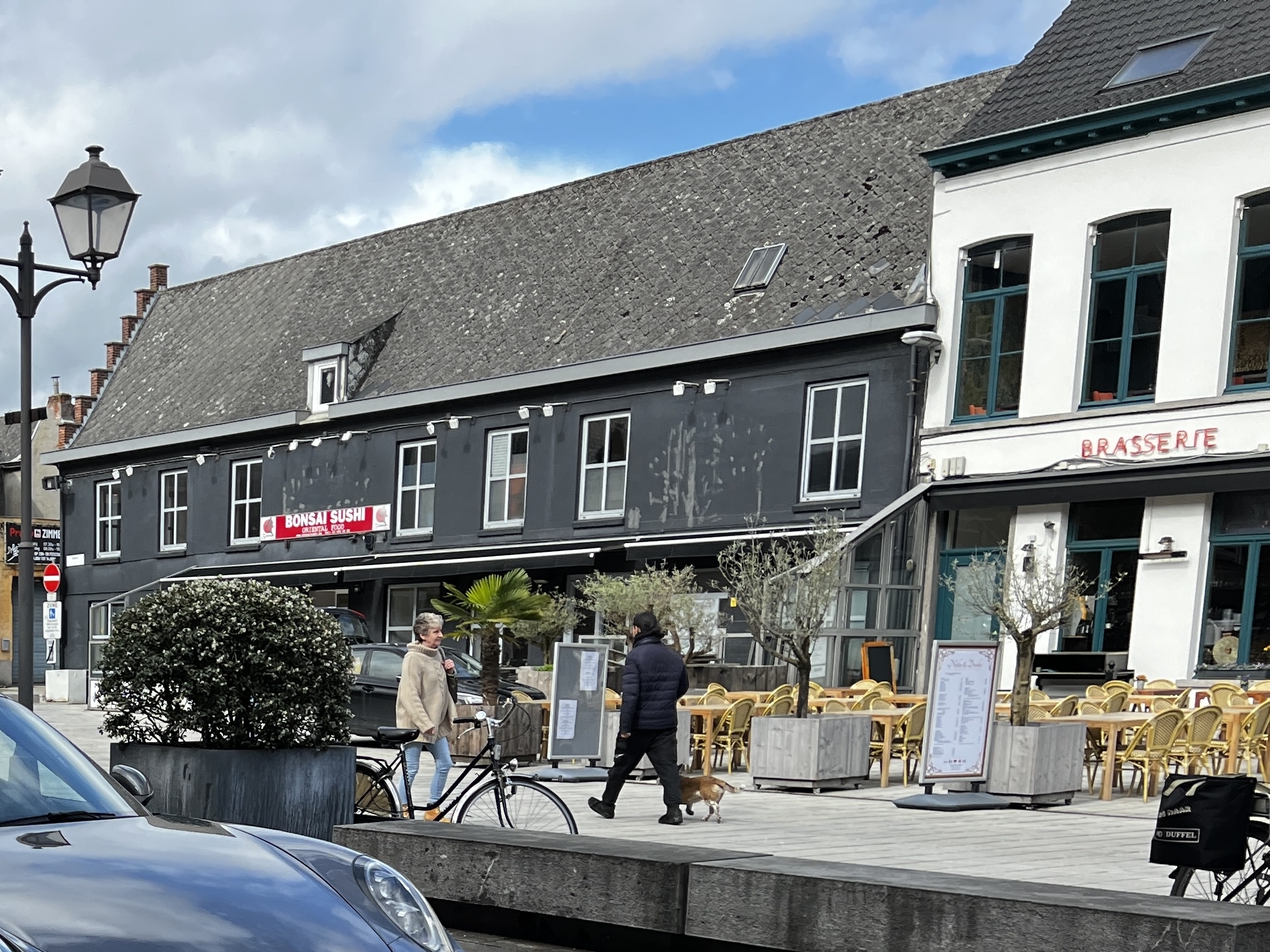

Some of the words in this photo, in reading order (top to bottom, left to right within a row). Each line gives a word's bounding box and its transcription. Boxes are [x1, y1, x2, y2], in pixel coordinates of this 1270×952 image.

[1081, 427, 1219, 458] BRASSERIE
[285, 511, 327, 528] BONSAI
[330, 507, 365, 523] SUSHI
[301, 525, 329, 534] ORIENTAL
[330, 523, 345, 531] FOOD
[1165, 831, 1197, 839] DUFFEL
